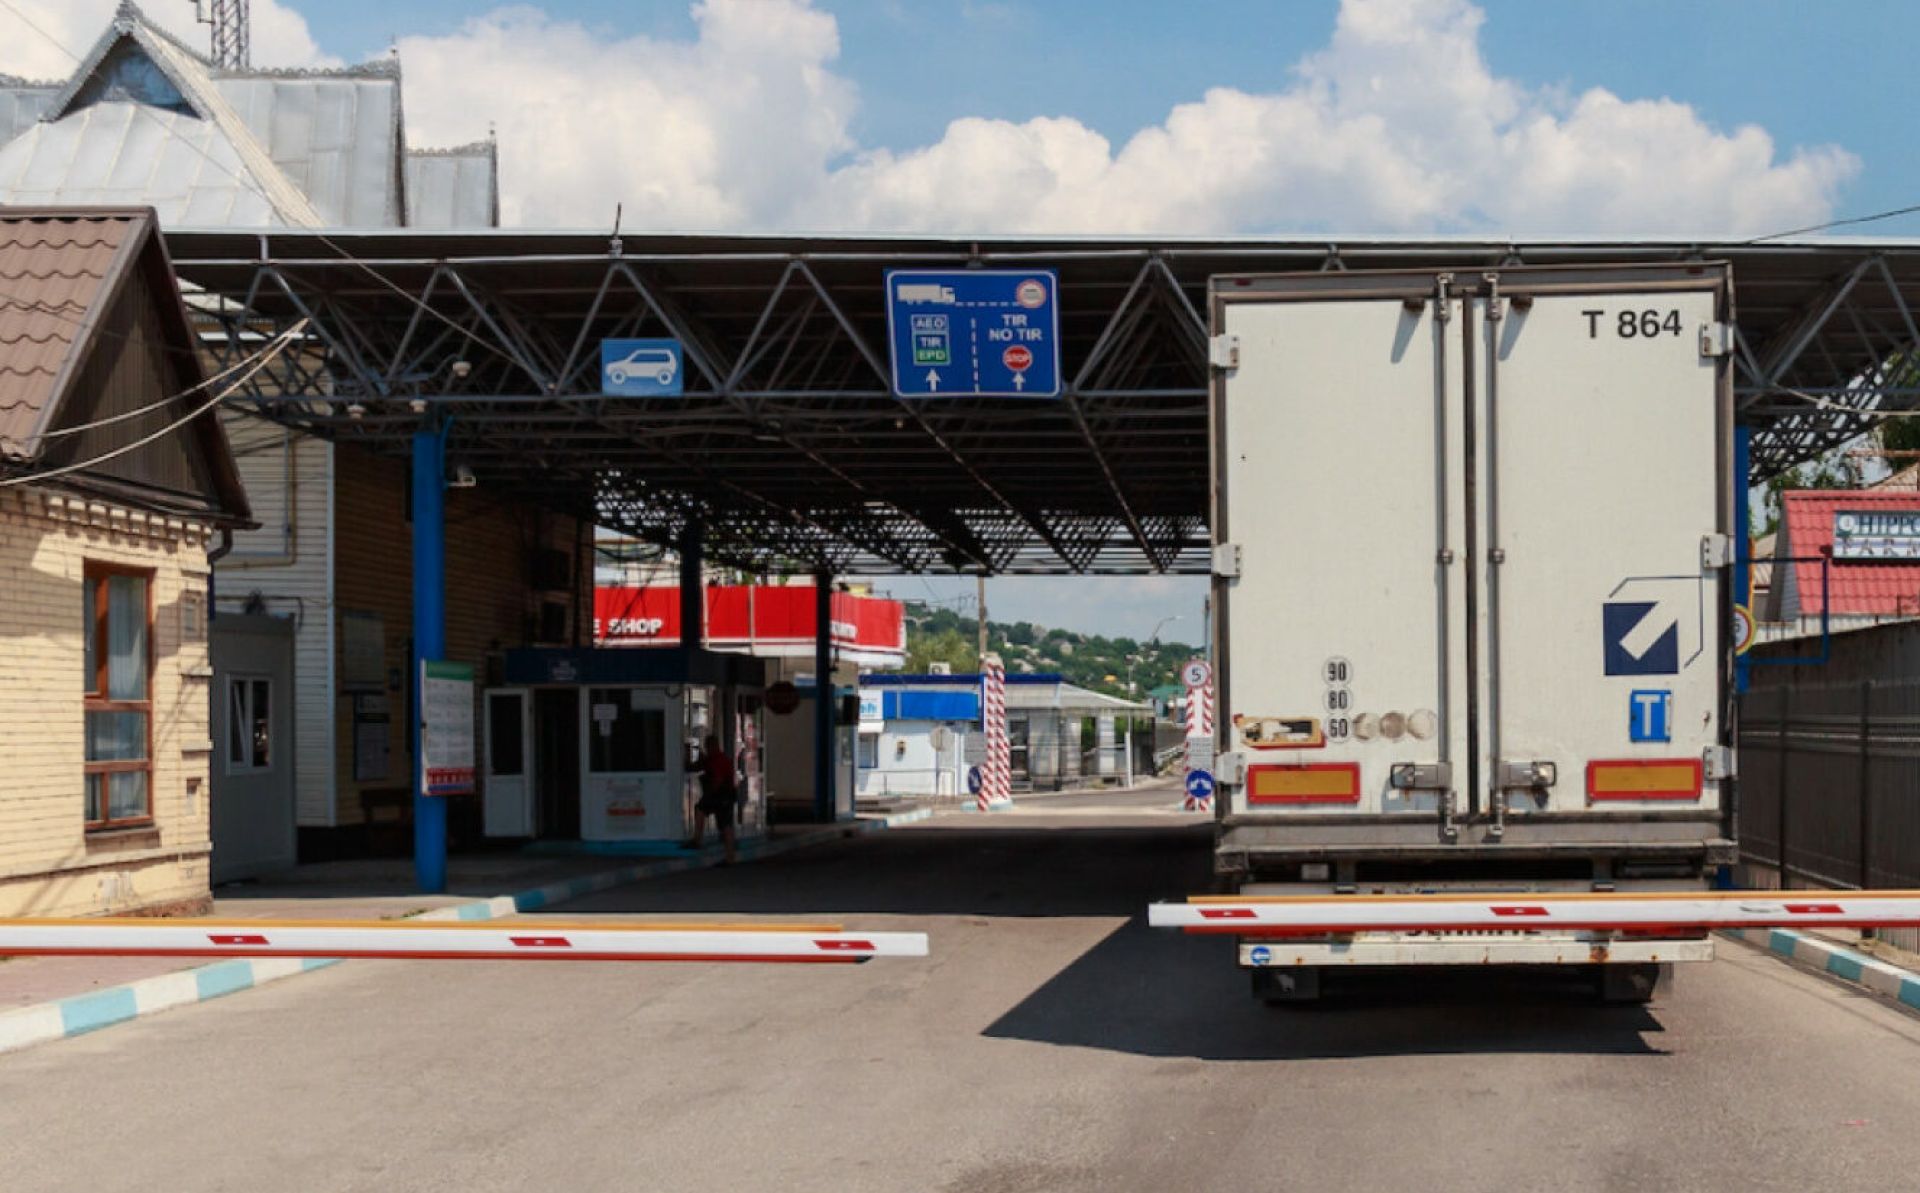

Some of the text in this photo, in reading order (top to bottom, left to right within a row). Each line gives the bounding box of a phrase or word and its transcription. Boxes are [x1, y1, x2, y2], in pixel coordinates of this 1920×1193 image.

[1001, 314, 1028, 326] TIR
[1582, 309, 1683, 338] T 864
[920, 336, 942, 347] TIR
[988, 328, 1043, 341] NO TIR
[608, 618, 663, 634] SHOP
[1191, 667, 1202, 682] 5
[1328, 661, 1347, 681] 90
[1329, 690, 1348, 709] 80
[1329, 718, 1348, 738] 60
